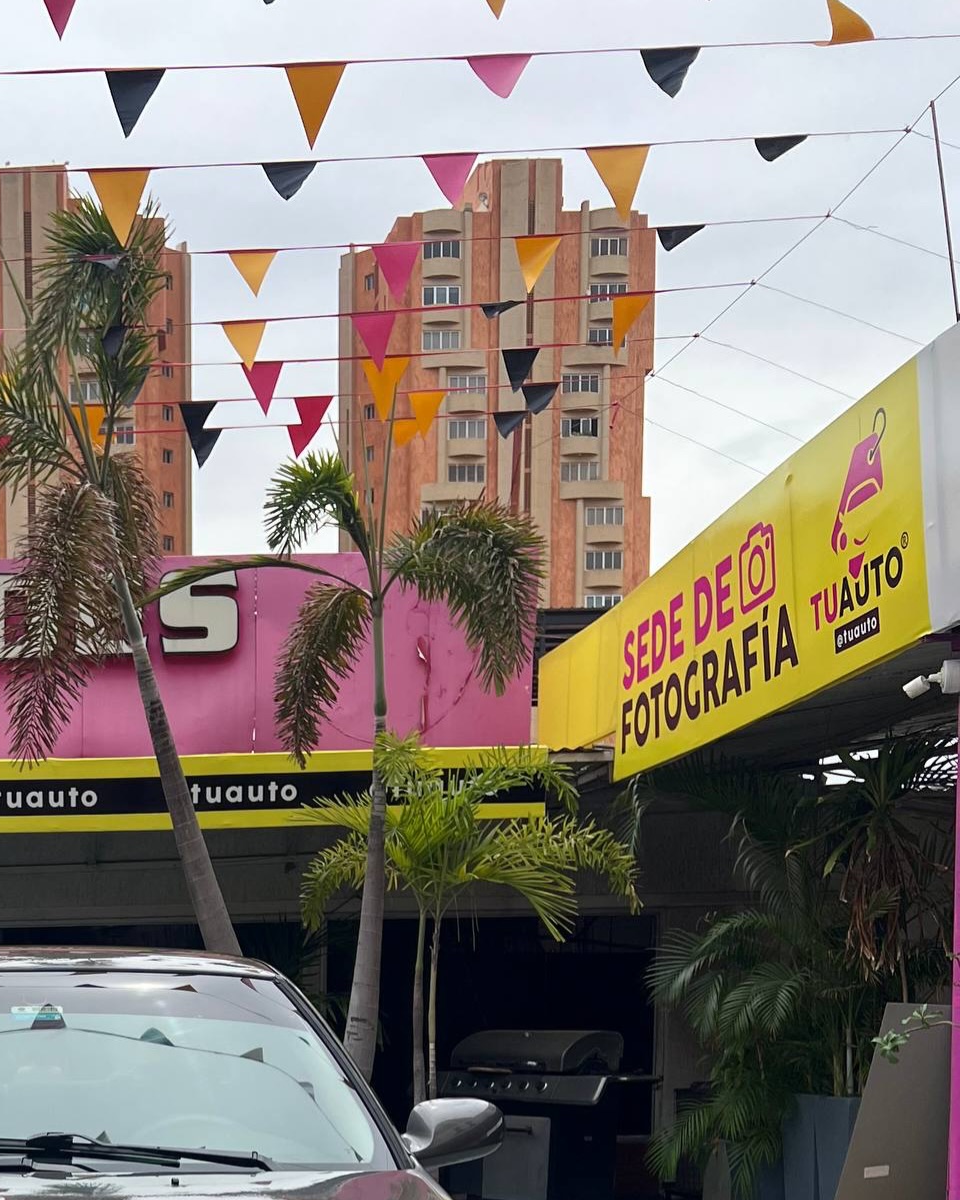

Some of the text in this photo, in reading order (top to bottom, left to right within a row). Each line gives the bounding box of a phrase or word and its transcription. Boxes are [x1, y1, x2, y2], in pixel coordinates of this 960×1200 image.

[622, 554, 735, 691] SEDE DE
[836, 616, 877, 648] @tuauto
[621, 603, 799, 755] FOTOGRAFÍA
[190, 780, 298, 805] tuauto
